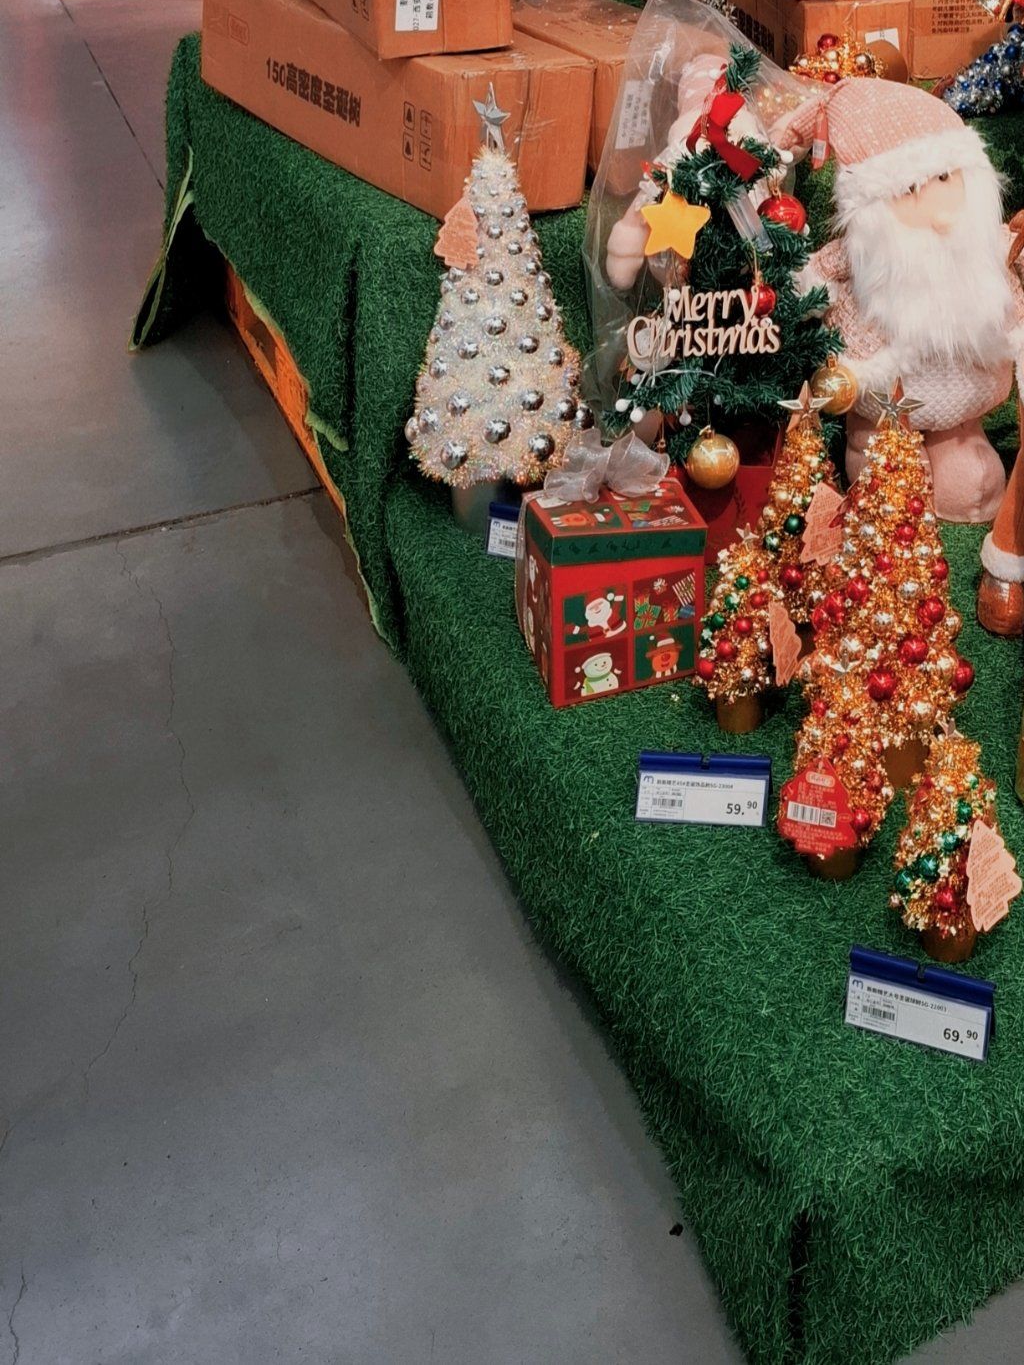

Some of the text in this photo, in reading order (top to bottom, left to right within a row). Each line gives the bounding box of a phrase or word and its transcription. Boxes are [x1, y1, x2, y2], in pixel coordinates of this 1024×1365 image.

[663, 284, 760, 329] Merry
[627, 315, 781, 359] Christmas
[725, 800, 758, 816] 59.90
[943, 1027, 979, 1045] 69.90
